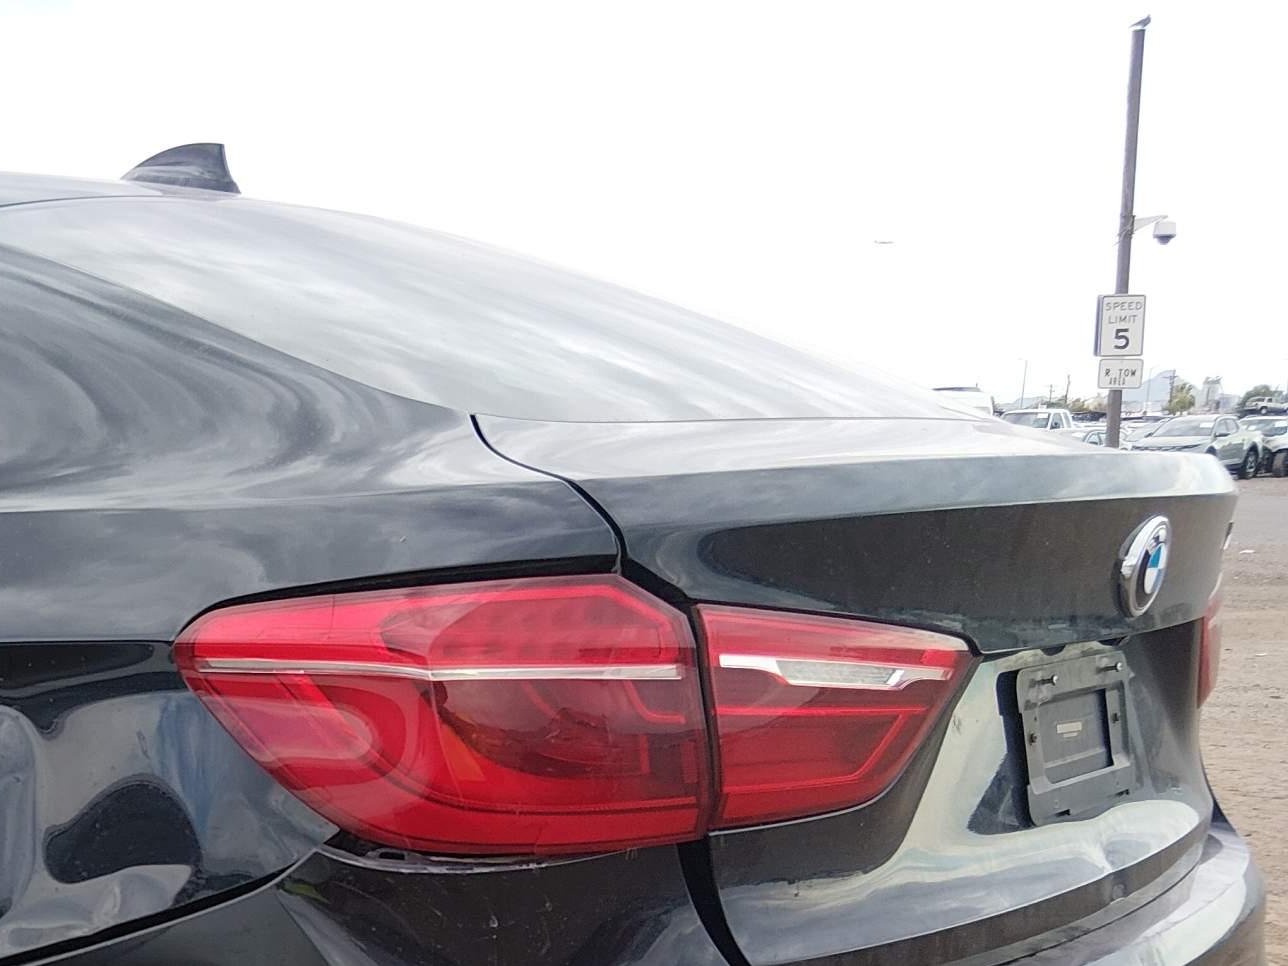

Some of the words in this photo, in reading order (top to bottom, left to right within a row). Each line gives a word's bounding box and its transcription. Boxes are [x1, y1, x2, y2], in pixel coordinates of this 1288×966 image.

[1105, 302, 1143, 311] SPEED
[1108, 315, 1137, 324] LIMIT
[1114, 328, 1129, 349] 5
